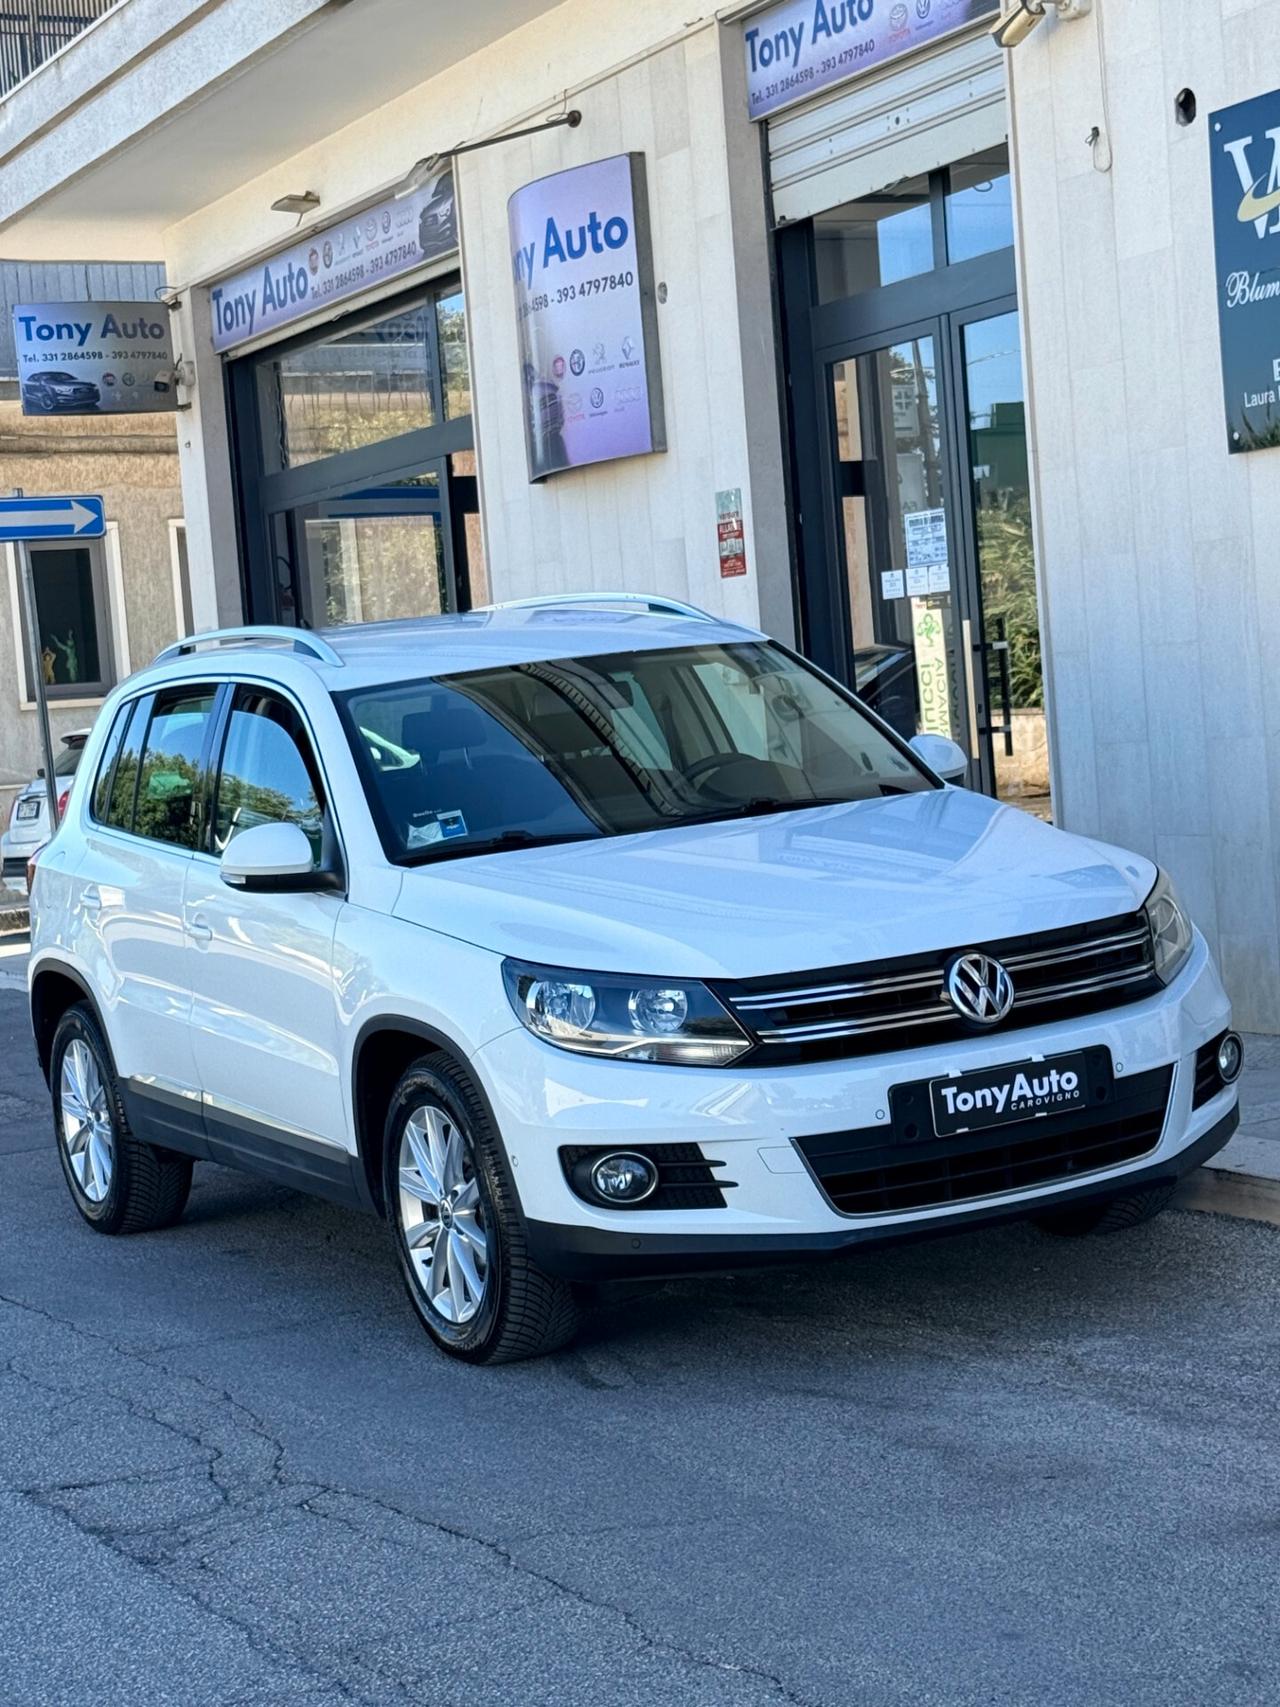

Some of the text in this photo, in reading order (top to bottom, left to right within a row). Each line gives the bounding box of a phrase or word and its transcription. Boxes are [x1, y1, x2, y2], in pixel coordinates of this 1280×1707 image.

[745, 0, 875, 73] Tony Auto
[751, 91, 764, 106] Tel.
[766, 79, 780, 99] 331
[779, 67, 815, 92] 2864598
[821, 56, 837, 73] 393
[838, 39, 876, 66] 4797840
[322, 278, 335, 294] 331
[370, 257, 383, 275] 393
[384, 241, 417, 267] 4797840
[513, 211, 629, 290] ny Auto
[212, 266, 309, 335] Tony Auto
[557, 285, 576, 304] 393
[579, 271, 634, 297] 4797840
[19, 313, 165, 346] Tony Auto
[23, 354, 39, 363] Tel.
[42, 352, 58, 362] 331
[61, 351, 103, 361] 2864598
[112, 350, 130, 360] 393
[131, 350, 168, 360] 4797840
[1243, 389, 1275, 408] Laura
[1011, 1090, 1080, 1110] CAROVIGNO
